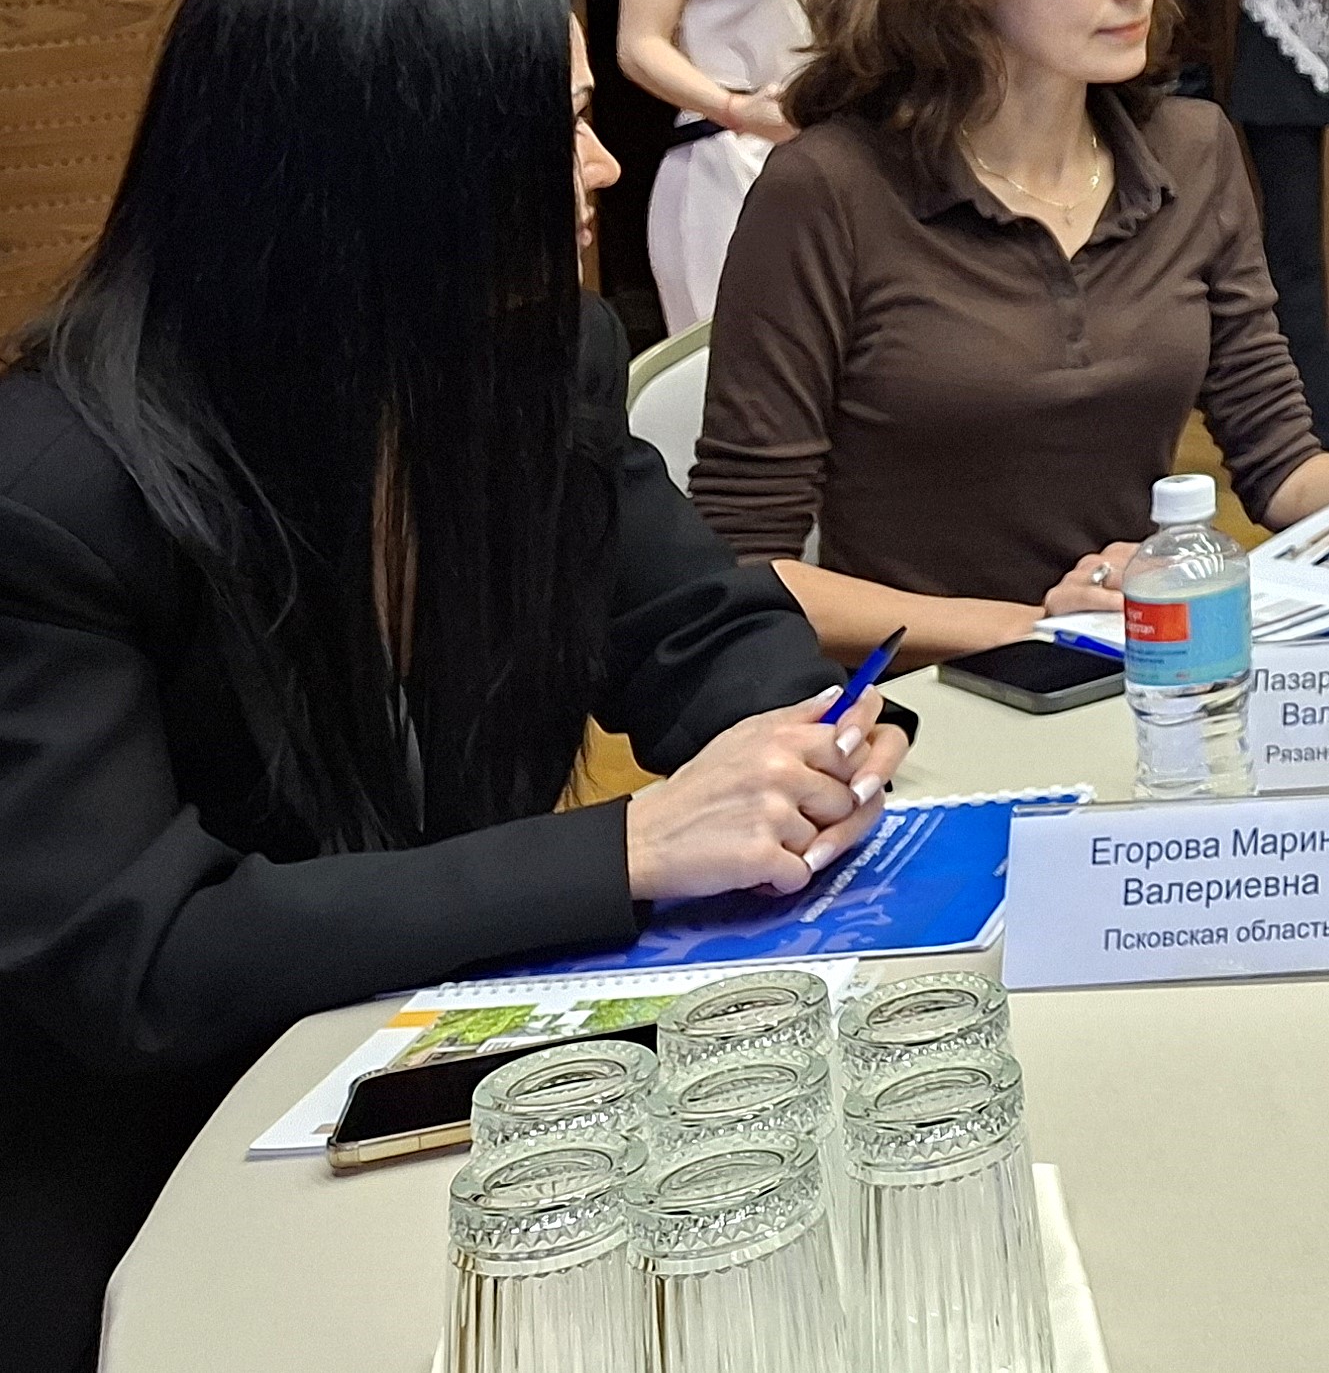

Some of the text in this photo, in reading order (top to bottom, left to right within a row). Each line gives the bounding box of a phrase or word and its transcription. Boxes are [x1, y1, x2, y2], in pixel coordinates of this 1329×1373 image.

[1091, 836, 1220, 869] Егорова
[1122, 873, 1320, 908] Валериевна
[1103, 927, 1228, 951] Псковская
